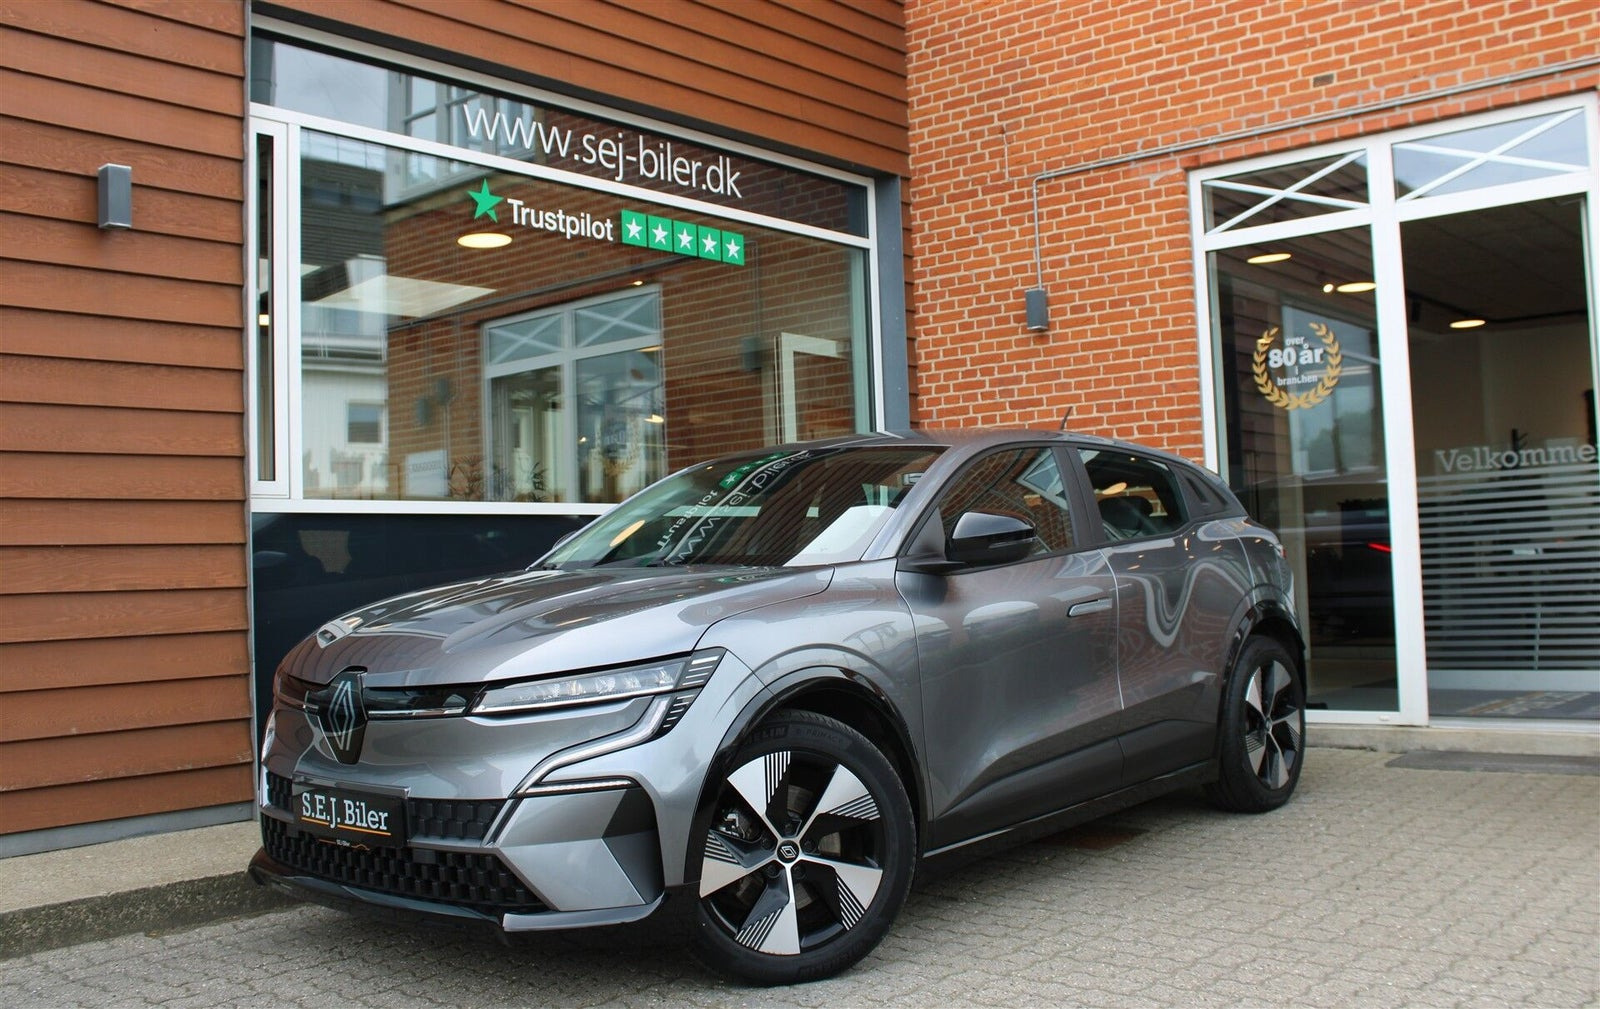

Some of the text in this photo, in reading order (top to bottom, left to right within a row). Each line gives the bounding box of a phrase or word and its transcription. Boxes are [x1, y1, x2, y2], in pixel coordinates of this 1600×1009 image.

[463, 103, 742, 198] www.sej-biler.dk
[507, 198, 613, 242] Trustpilot
[1268, 343, 1324, 368] 80 år
[1436, 443, 1597, 472] Velkomme
[302, 792, 389, 830] S.E.J. Biler
